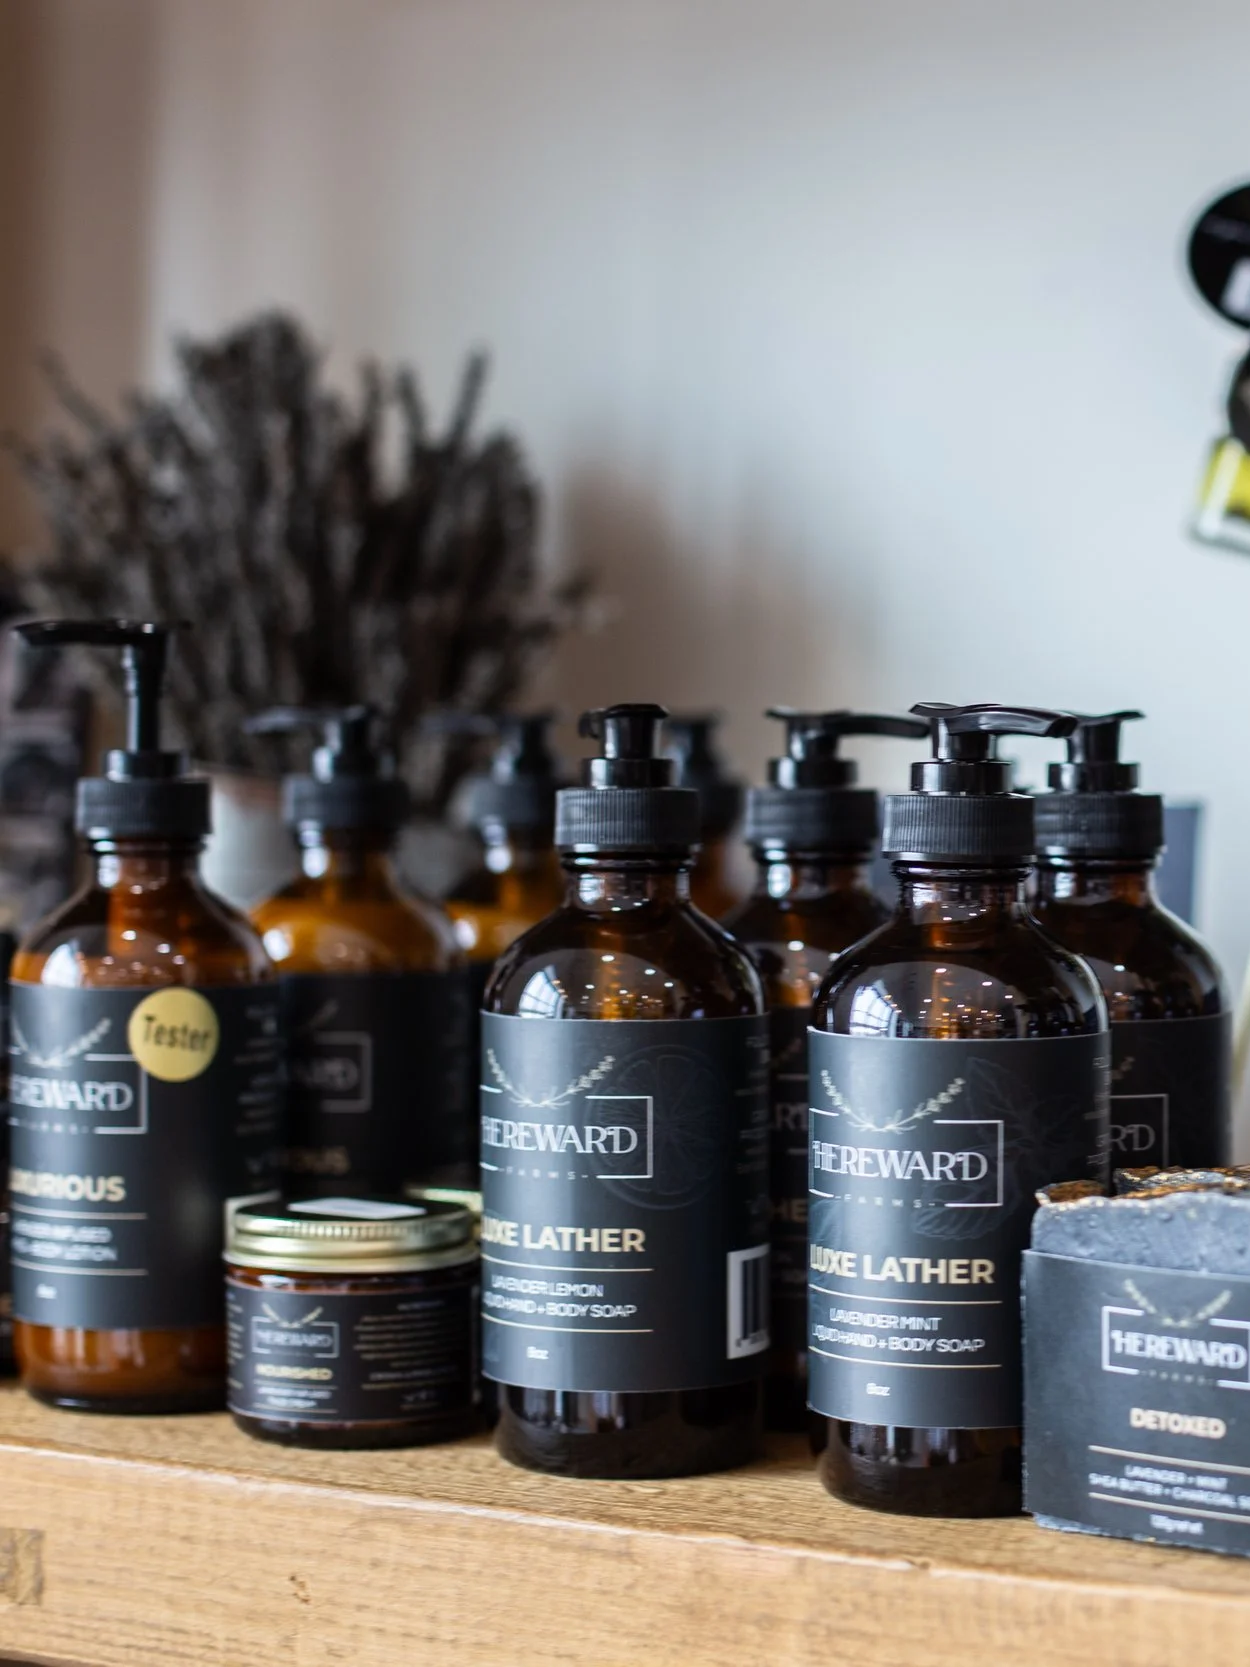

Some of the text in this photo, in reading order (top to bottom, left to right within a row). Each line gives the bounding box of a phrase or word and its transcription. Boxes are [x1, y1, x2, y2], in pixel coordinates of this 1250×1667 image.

[144, 1015, 212, 1052] Tester
[812, 1140, 988, 1182] HEREWARD
[523, 1224, 646, 1253] LATHER
[810, 1243, 858, 1279] LUXE
[862, 1255, 995, 1285] LATHER
[546, 1302, 590, 1317] BODY
[590, 1304, 638, 1318] SOAP
[900, 1316, 943, 1330] MINT
[888, 1336, 935, 1351] BODY
[936, 1338, 986, 1352] SOAP
[1110, 1329, 1248, 1369] HEREWARD
[1129, 1407, 1226, 1439] DETOXED
